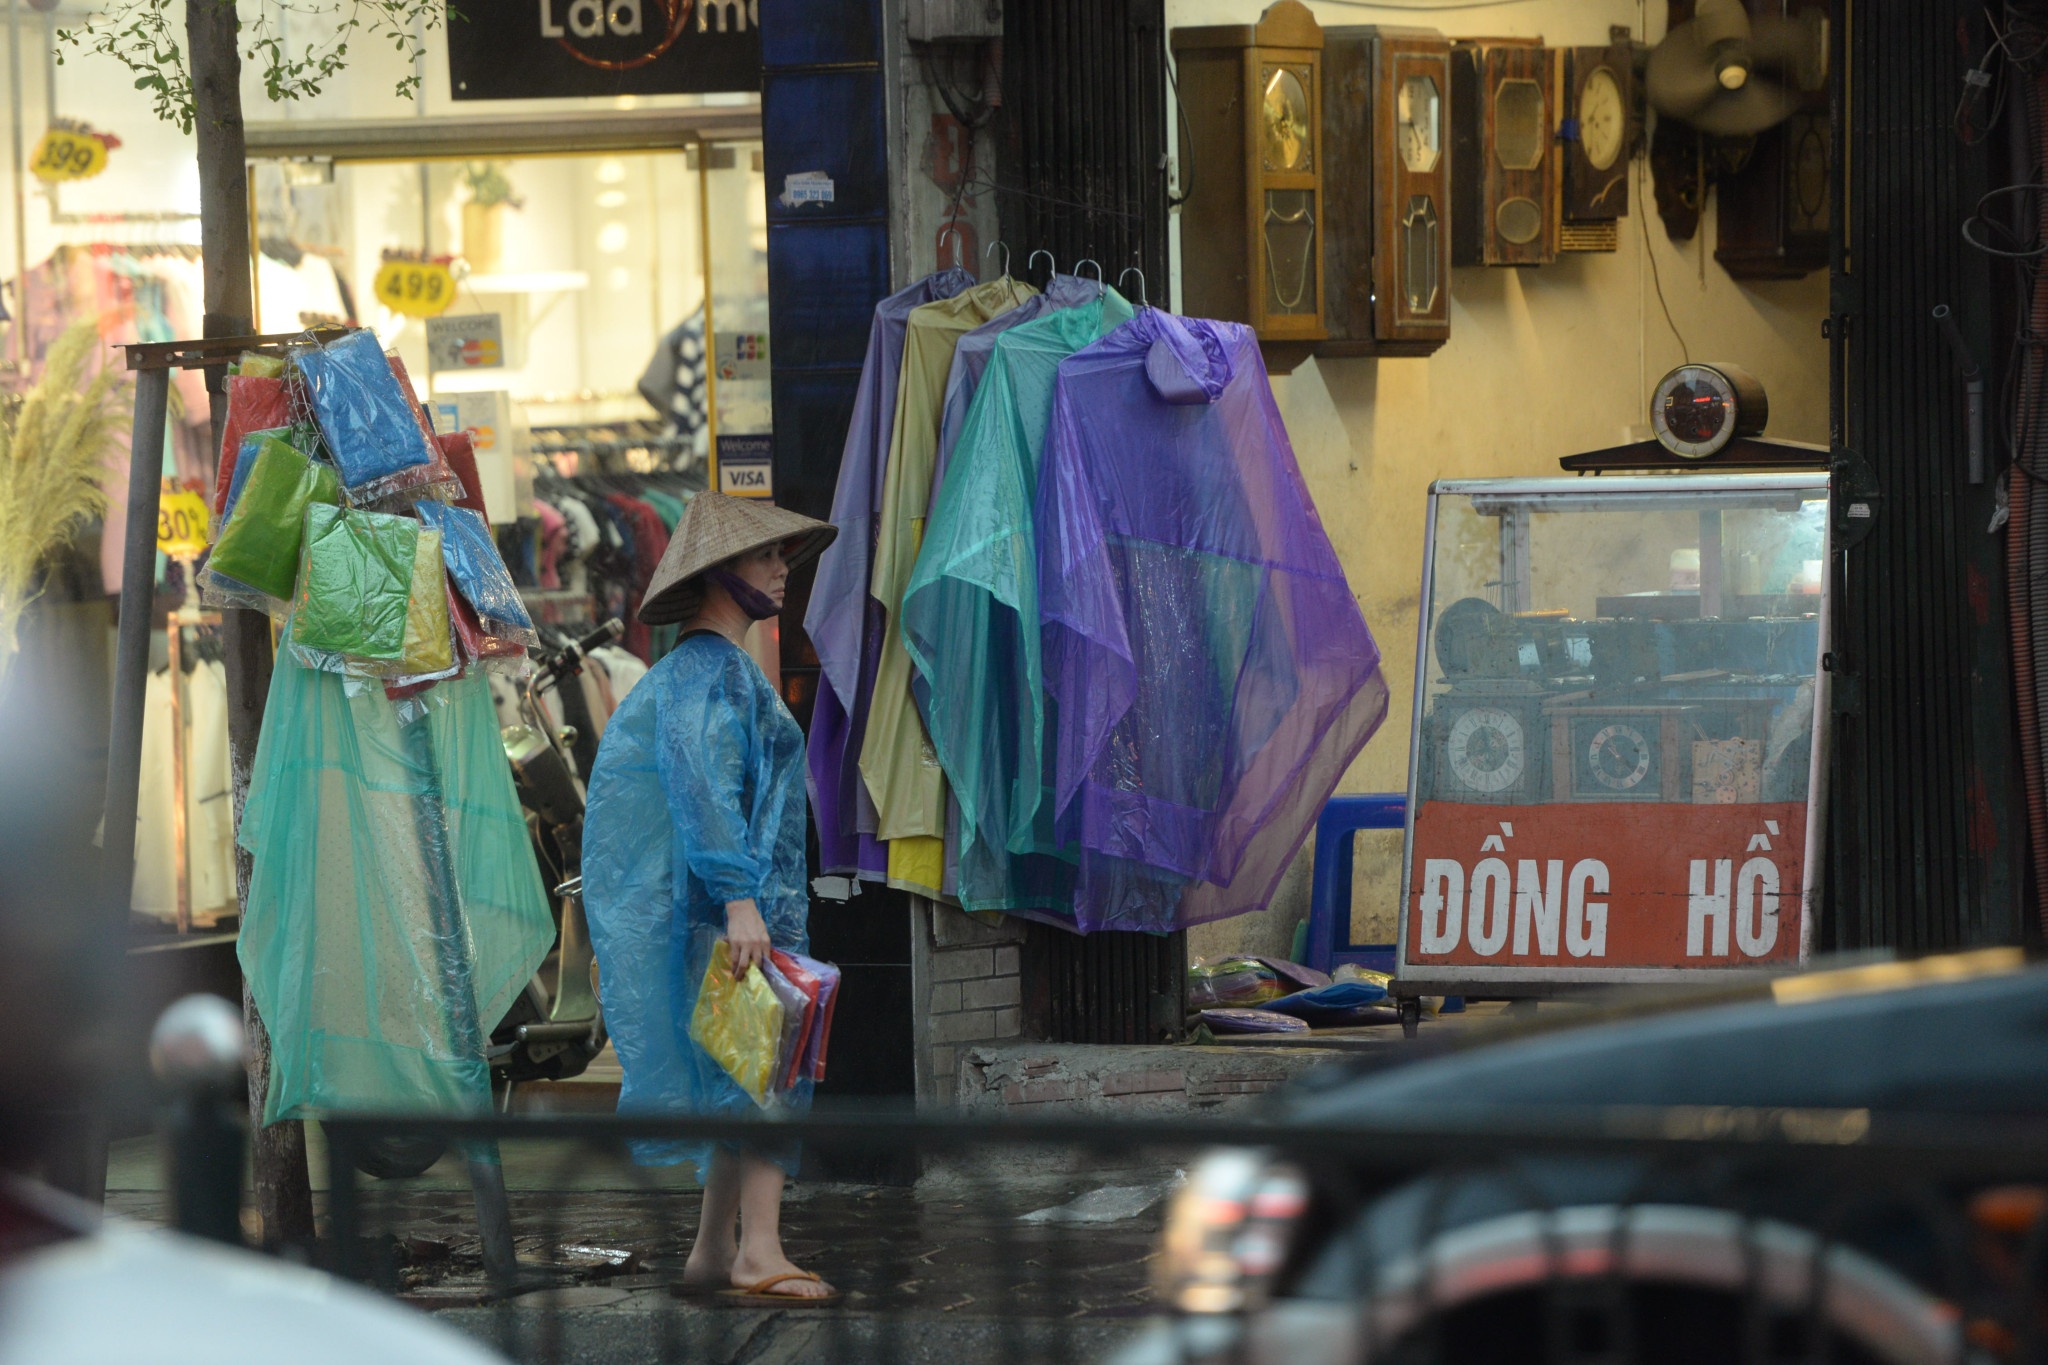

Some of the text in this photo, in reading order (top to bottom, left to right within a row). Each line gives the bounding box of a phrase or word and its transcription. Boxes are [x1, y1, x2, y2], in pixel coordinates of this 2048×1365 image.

[386, 271, 443, 303] 499
[432, 318, 494, 332] WELCOME
[729, 470, 765, 486] VISA
[1420, 820, 1780, 958] ĐỒNG HỒ
